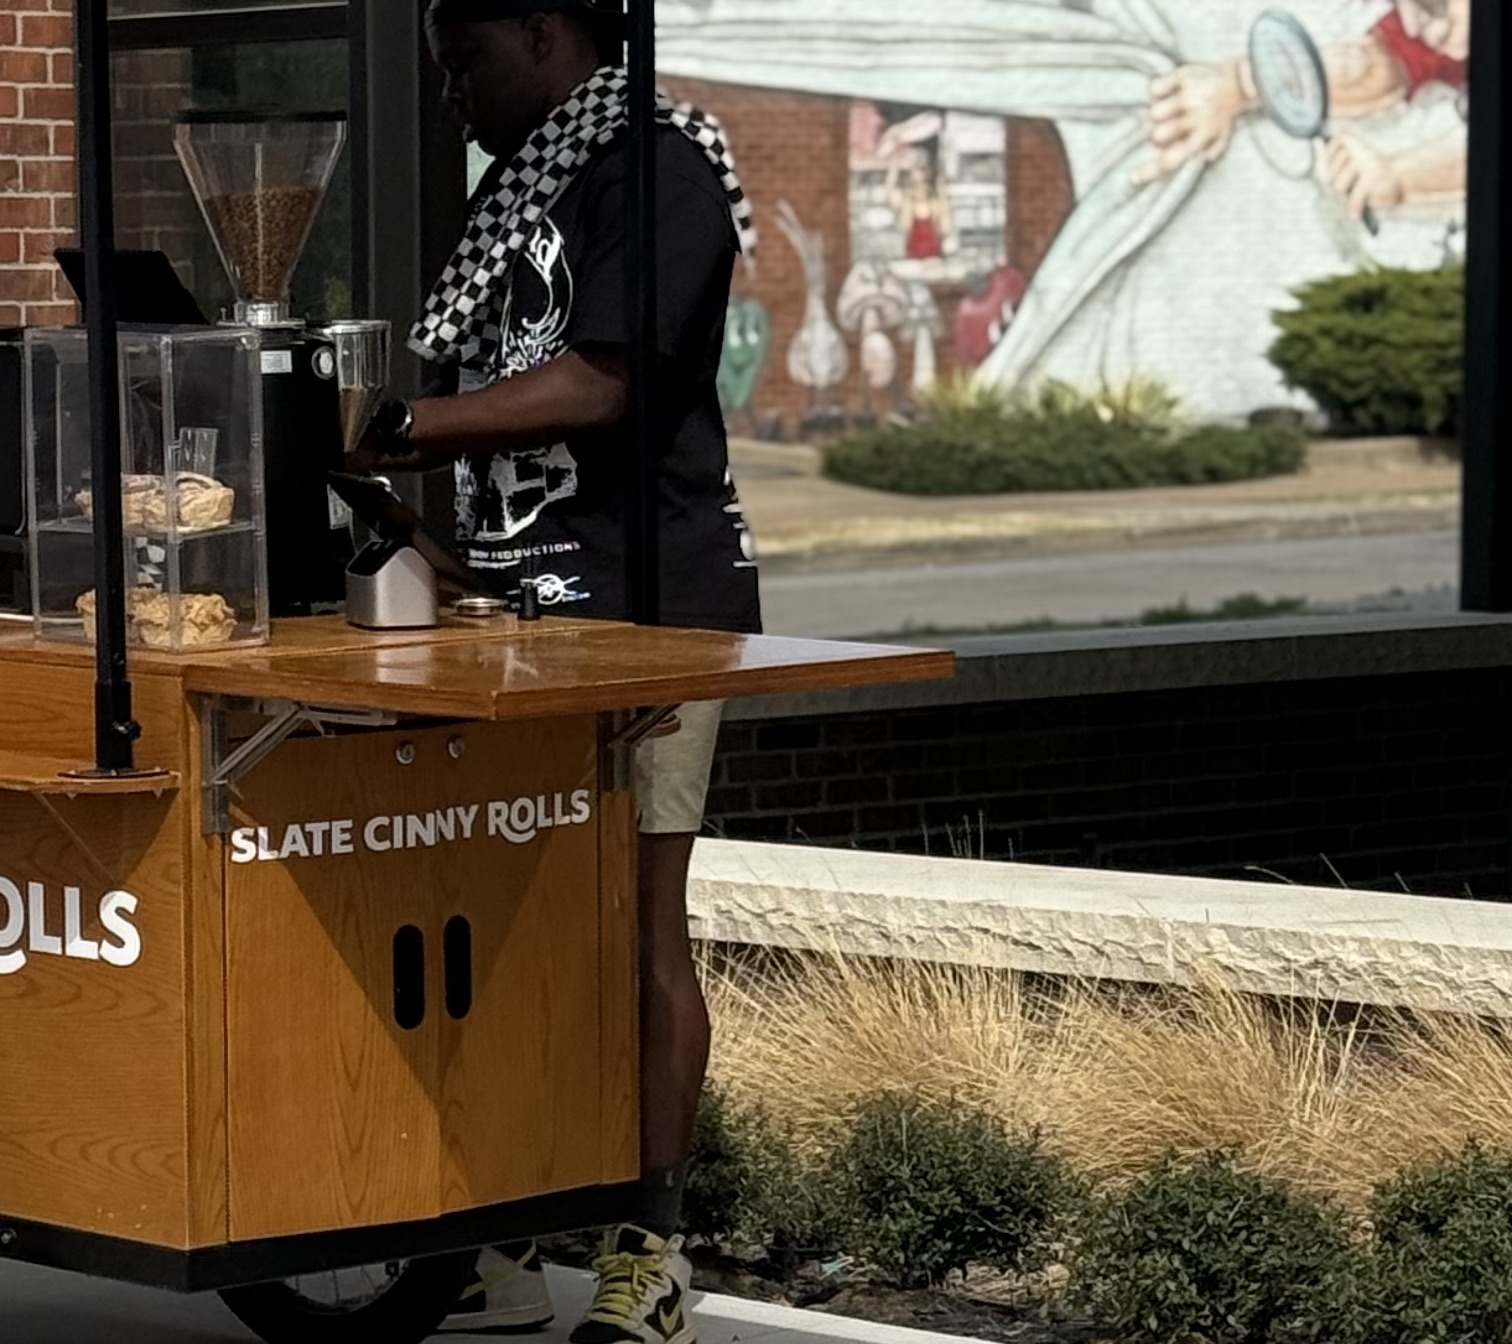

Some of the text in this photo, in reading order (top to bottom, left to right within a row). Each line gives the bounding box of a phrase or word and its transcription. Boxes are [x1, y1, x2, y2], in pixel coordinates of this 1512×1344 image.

[230, 788, 591, 864] SLATE CINNY ROLLS
